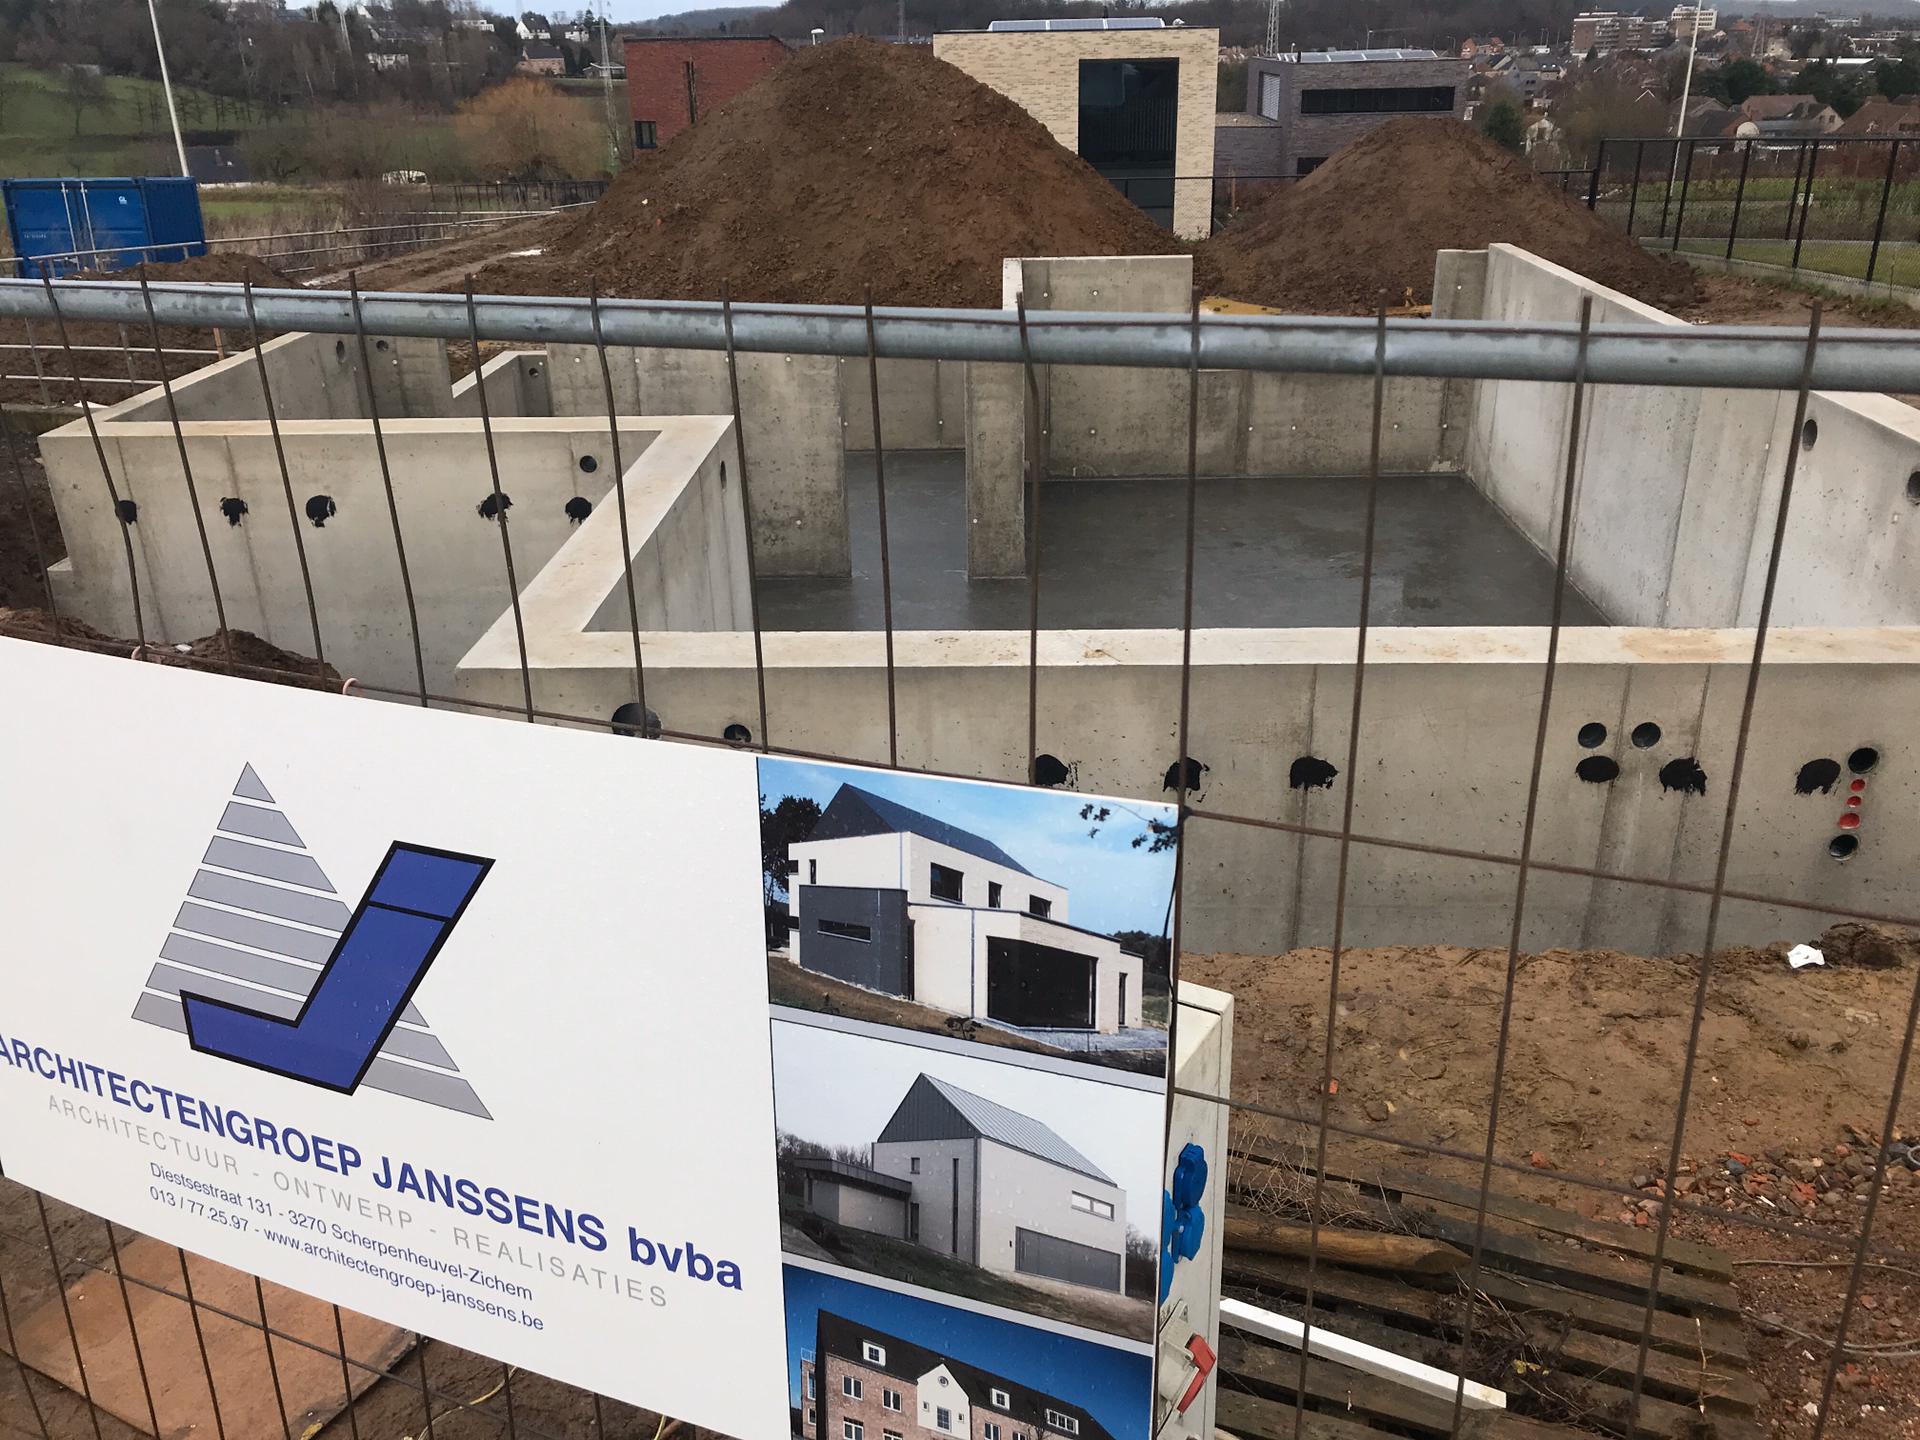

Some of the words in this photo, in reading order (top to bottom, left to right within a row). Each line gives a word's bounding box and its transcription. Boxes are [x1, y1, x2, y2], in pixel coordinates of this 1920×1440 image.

[48, 1094, 240, 1176] ARCHITECTUUR
[273, 1171, 412, 1229] ONTWERP
[453, 1226, 667, 1308] REALISATIES
[150, 1162, 243, 1207] Diestsestraat
[247, 1196, 273, 1217] 131
[288, 1209, 328, 1235] 3270
[331, 1223, 533, 1301] Scherpenheuvel-Zichem
[150, 1186, 176, 1207] 013
[187, 1199, 249, 1232] 77.25.97
[263, 1228, 545, 1331] www.architectengroep-janssens.be
[372, 1155, 608, 1252] JANSSENS
[628, 1226, 743, 1291] bvba
